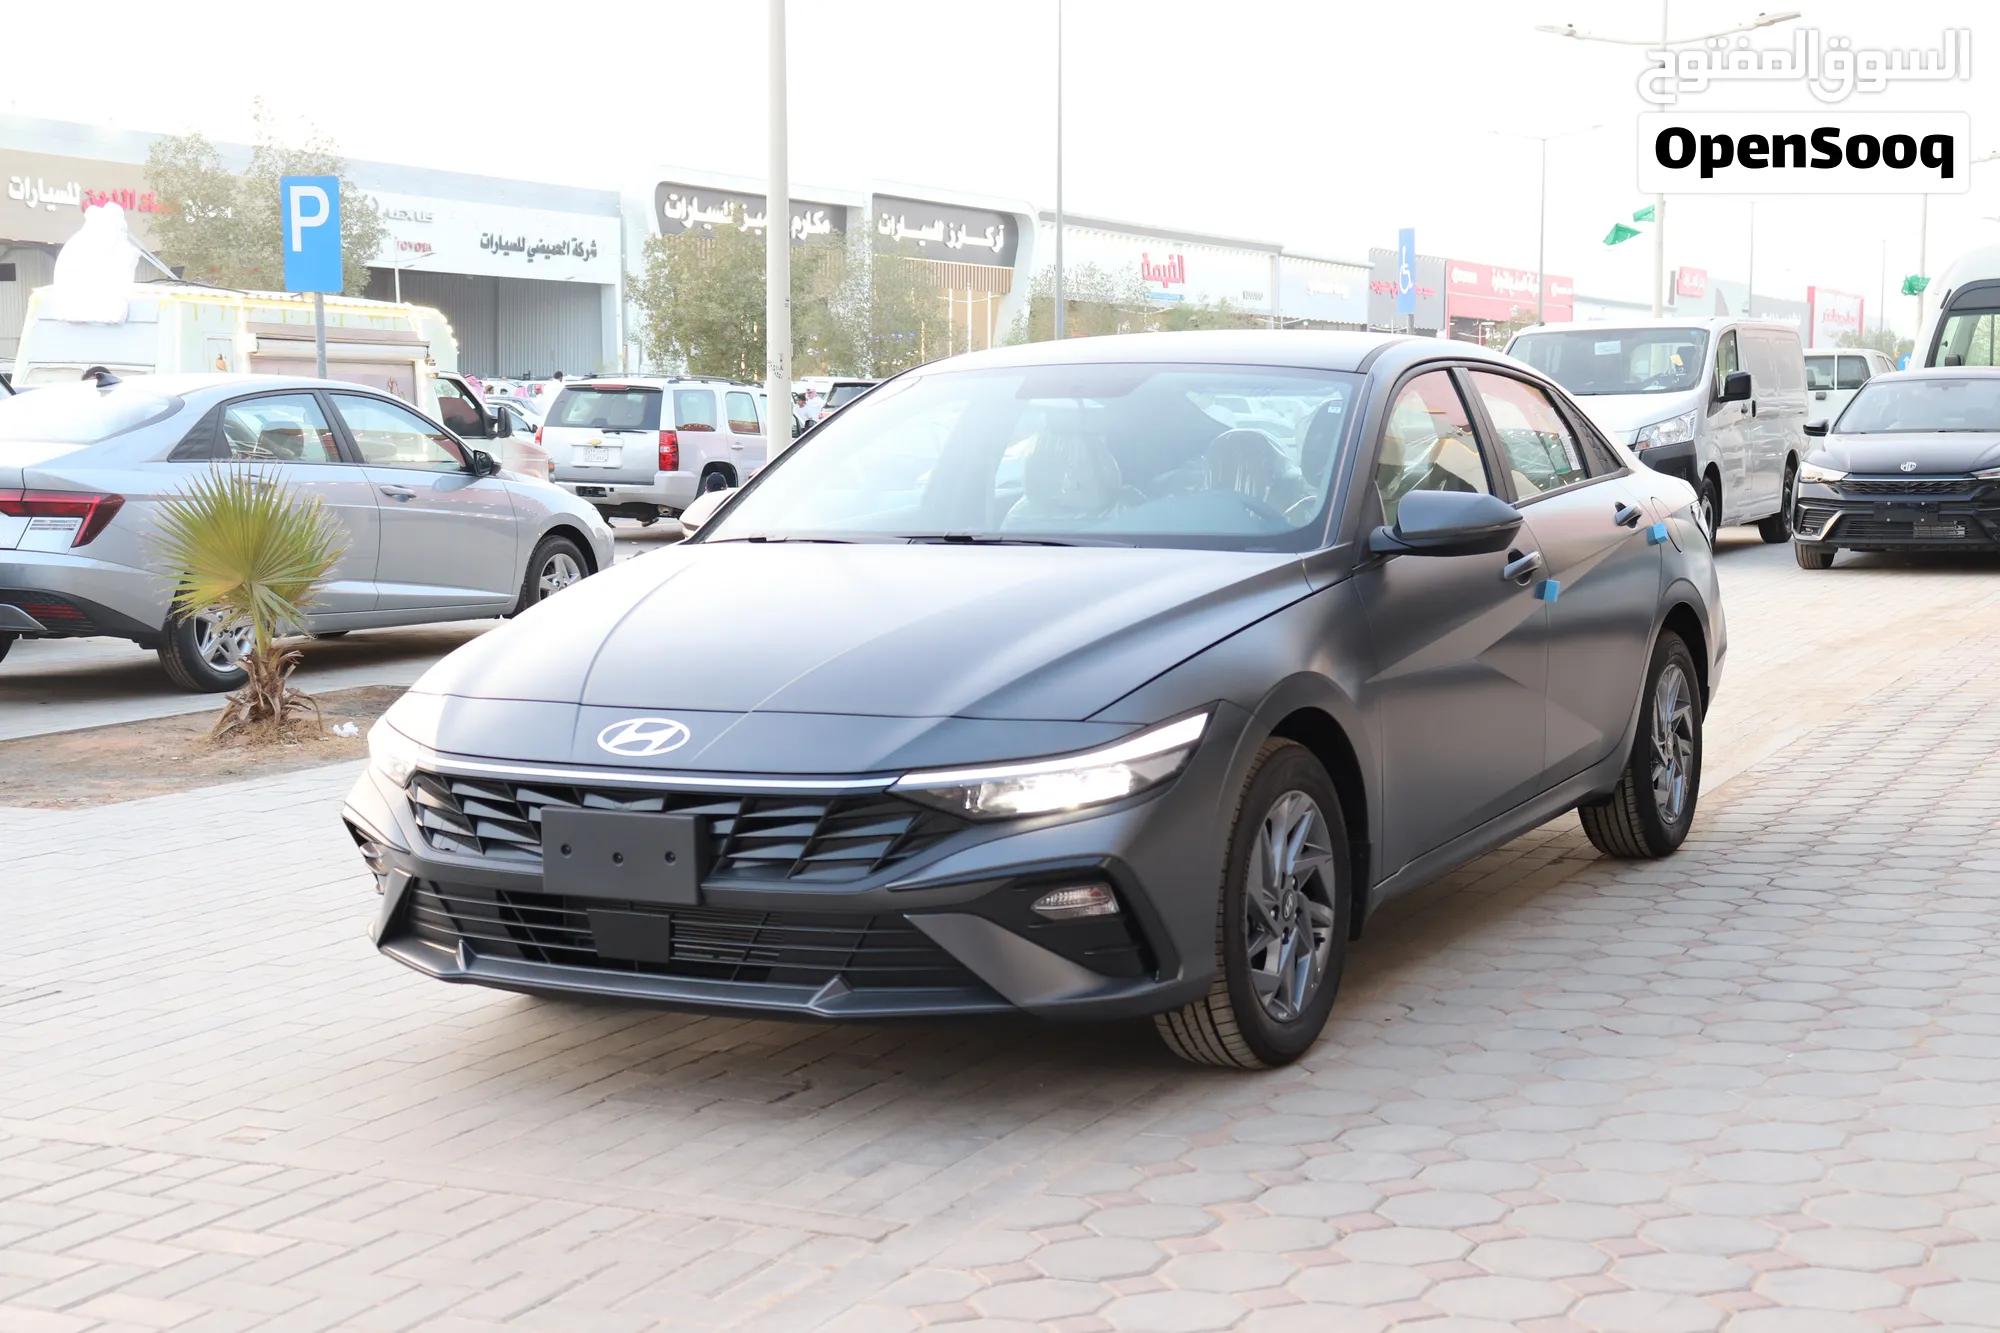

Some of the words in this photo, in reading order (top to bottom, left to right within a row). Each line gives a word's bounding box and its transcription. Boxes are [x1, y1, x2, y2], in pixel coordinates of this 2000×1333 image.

[8, 175, 81, 212] للسيارات
[290, 185, 330, 252] P
[480, 232, 526, 257] للسيارات
[571, 237, 598, 262] شركة
